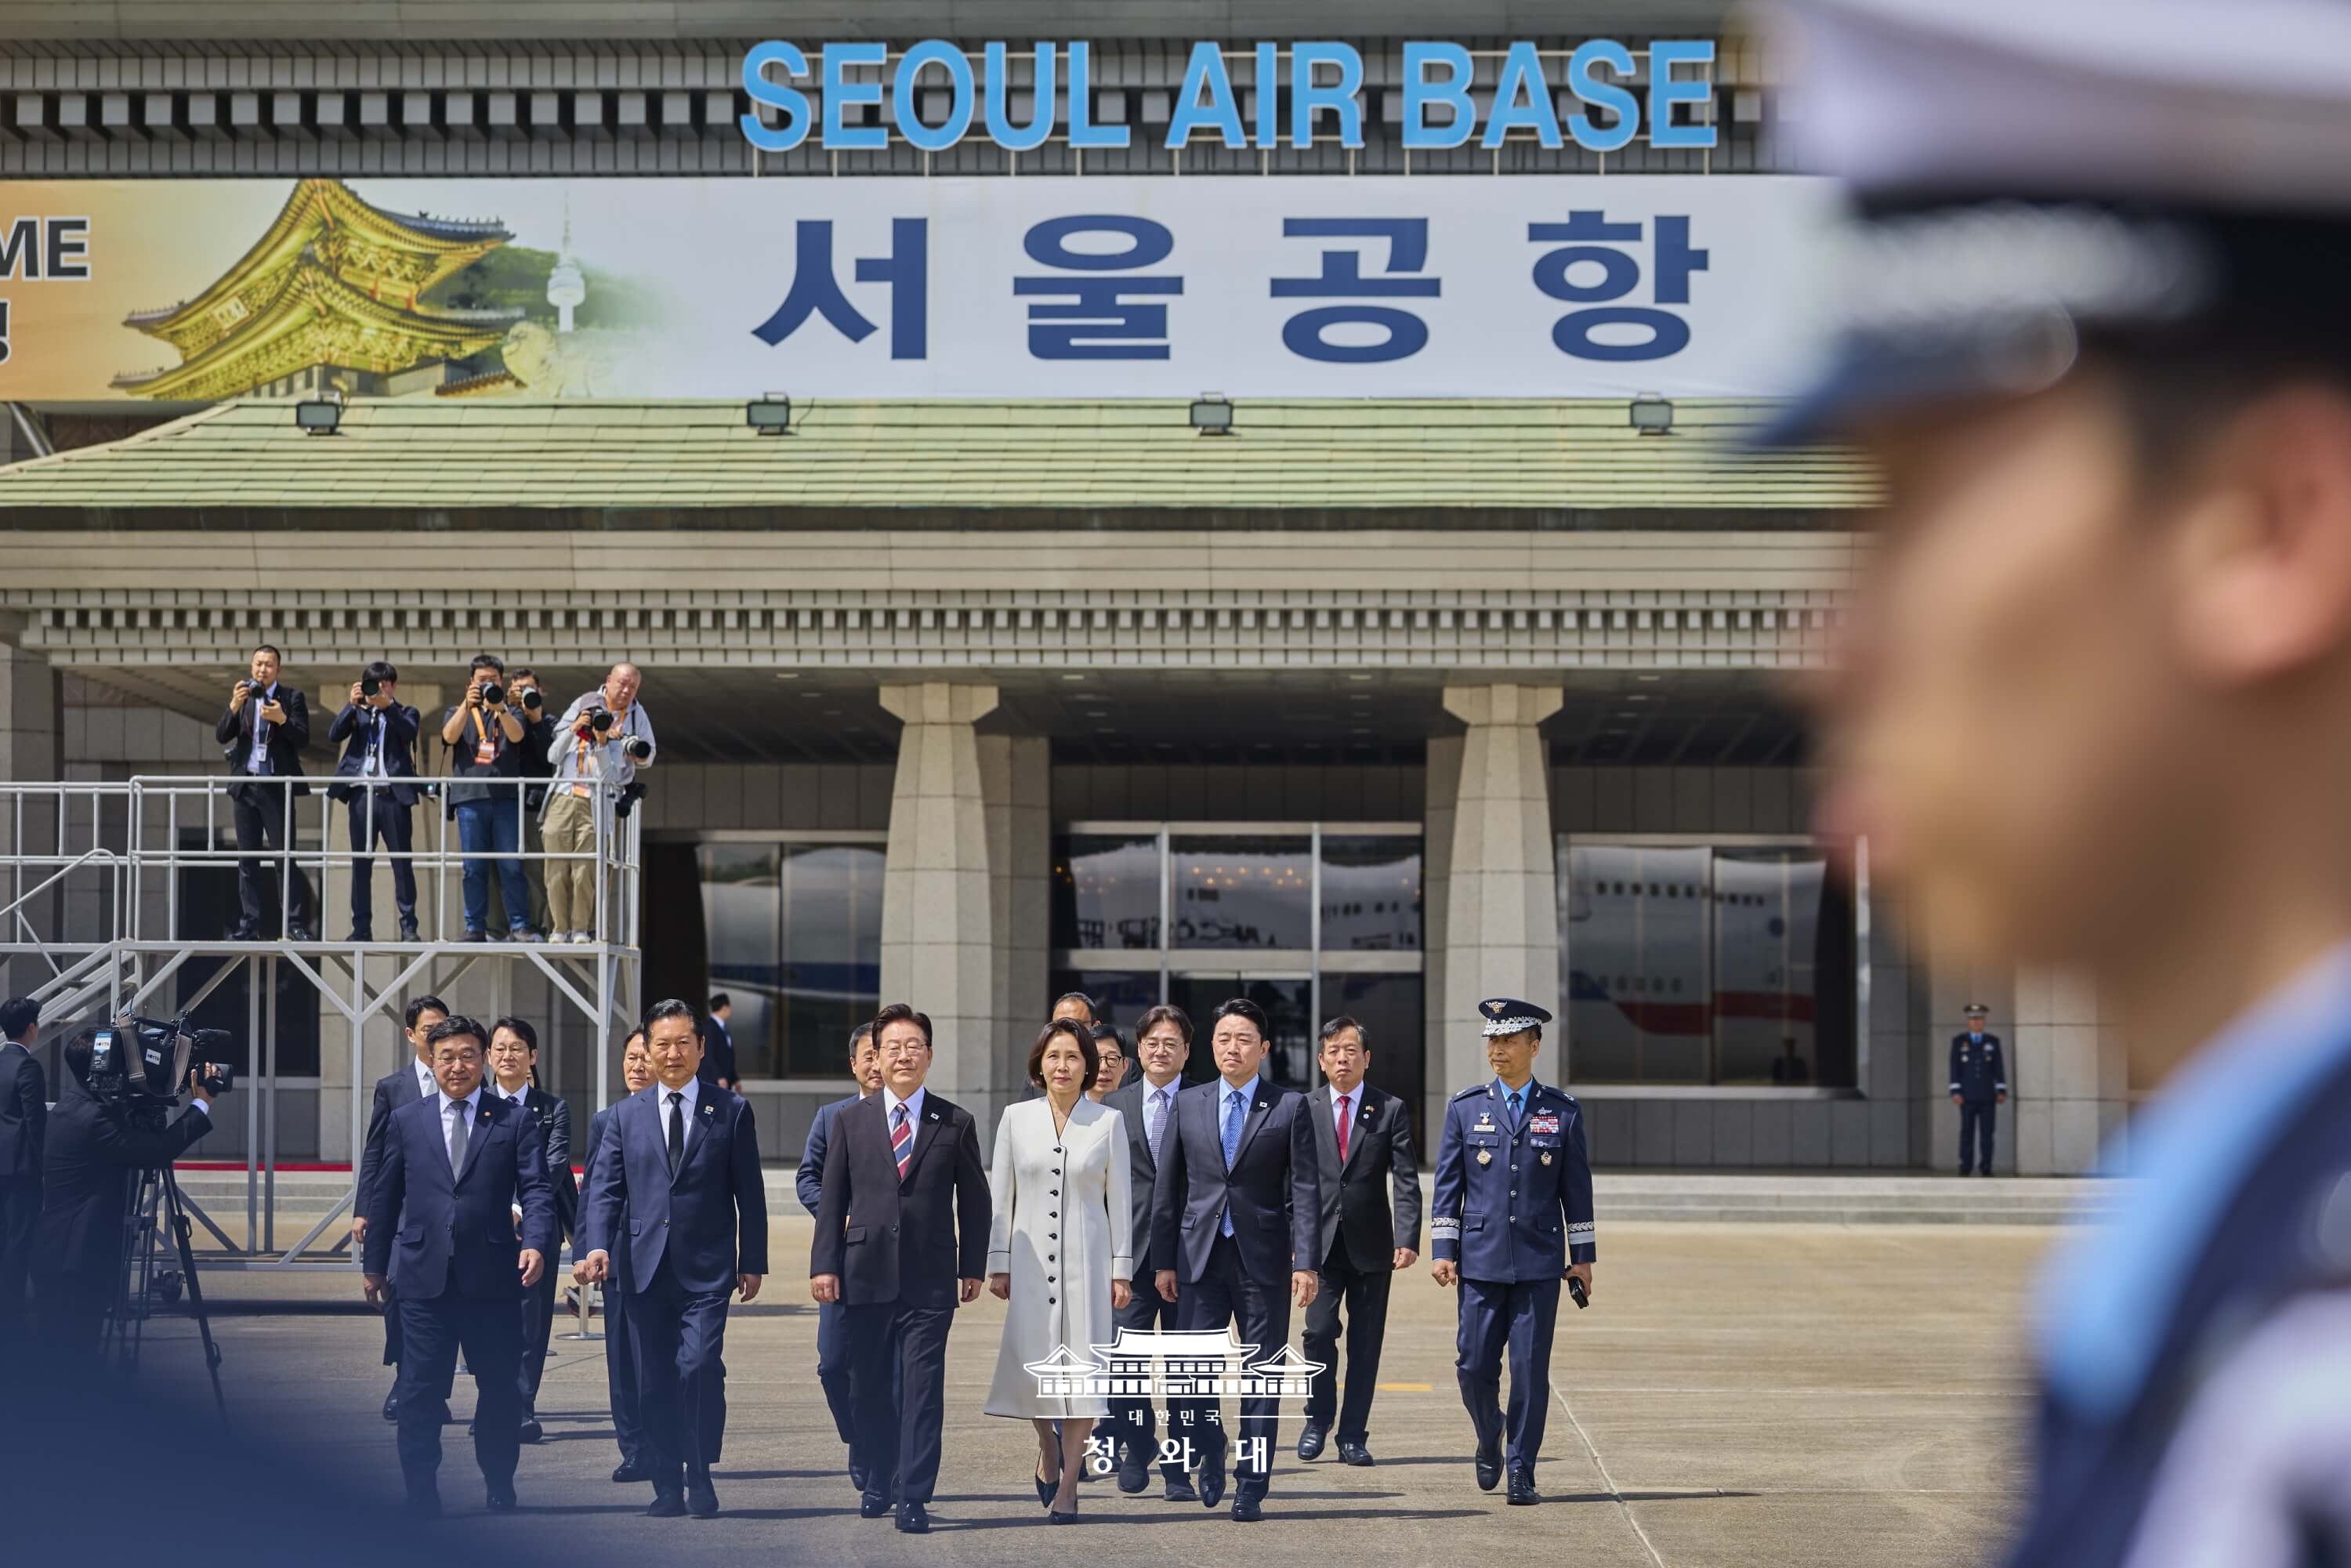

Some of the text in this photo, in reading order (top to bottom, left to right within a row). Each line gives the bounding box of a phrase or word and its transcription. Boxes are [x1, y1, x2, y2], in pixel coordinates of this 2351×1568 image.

[740, 39, 1717, 151] SEOUL AIR BASE
